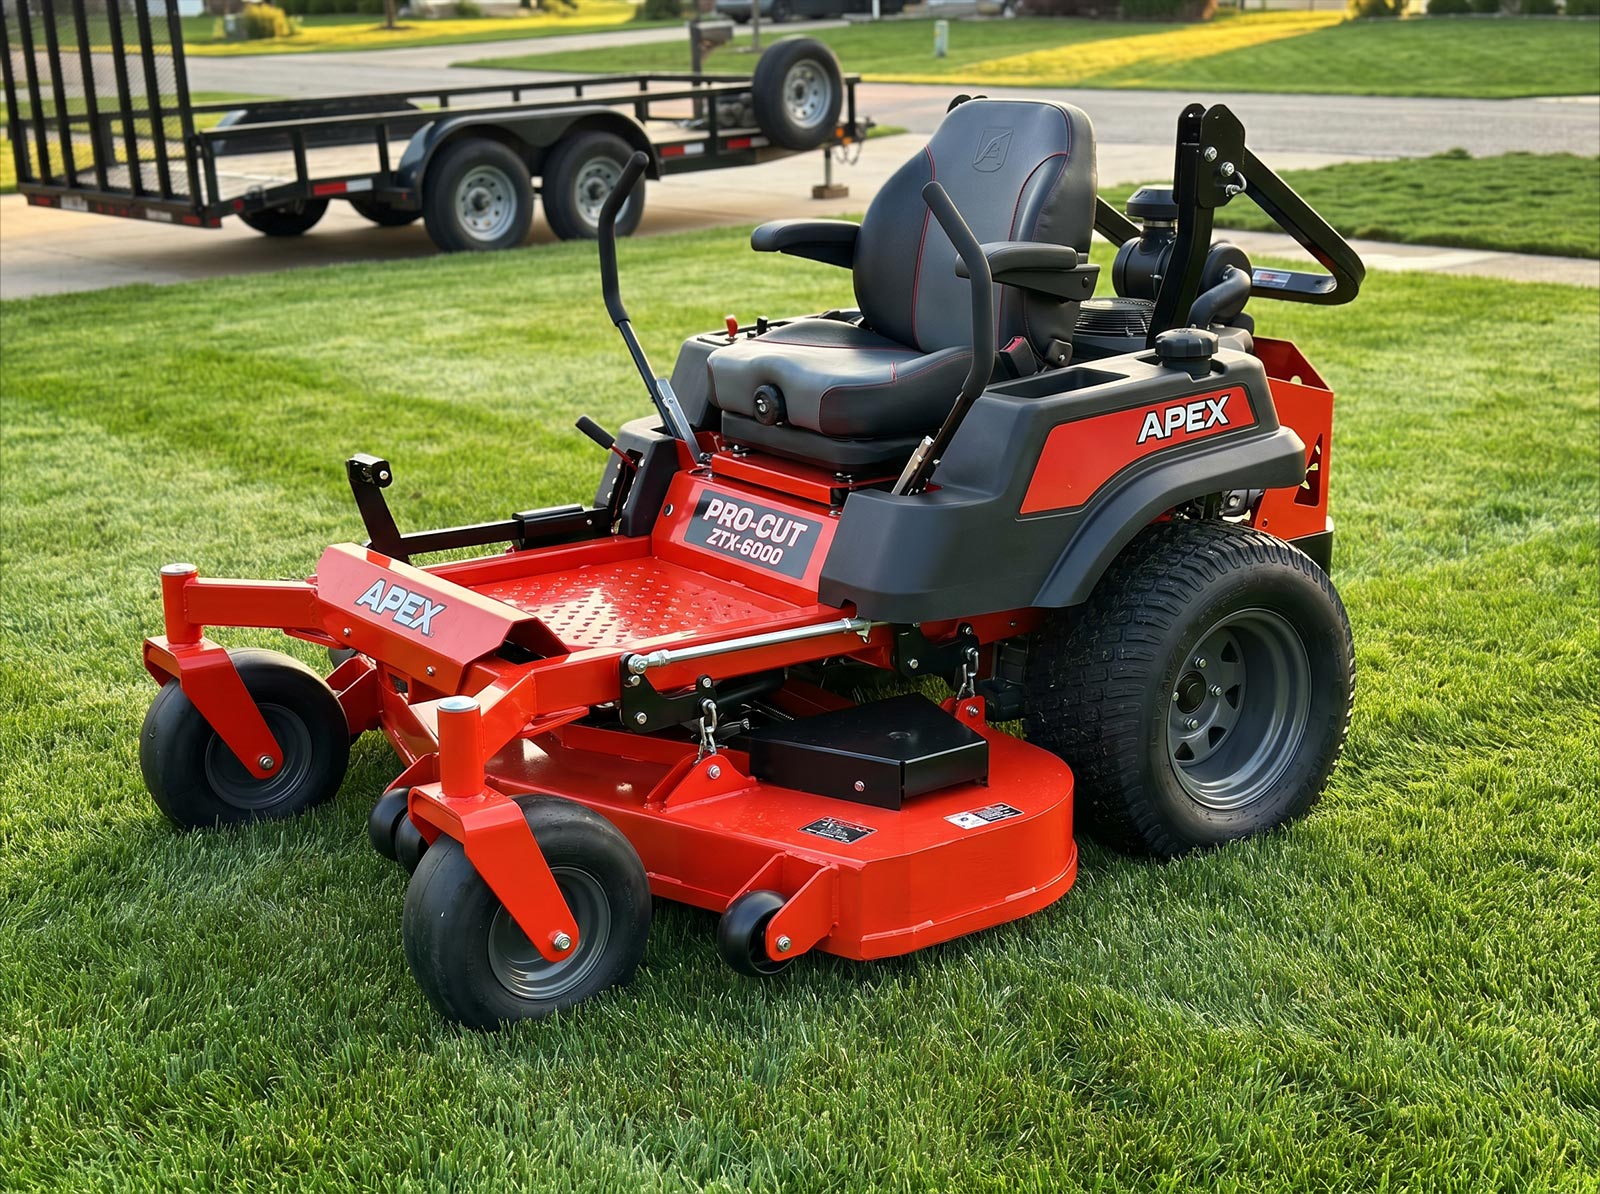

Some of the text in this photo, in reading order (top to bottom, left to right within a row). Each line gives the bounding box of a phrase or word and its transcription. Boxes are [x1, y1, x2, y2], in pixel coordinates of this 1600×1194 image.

[1136, 394, 1231, 445] APEX
[702, 498, 808, 547] PRO-CUT
[706, 527, 784, 565] ZTX-6000
[354, 578, 447, 636] APEX
